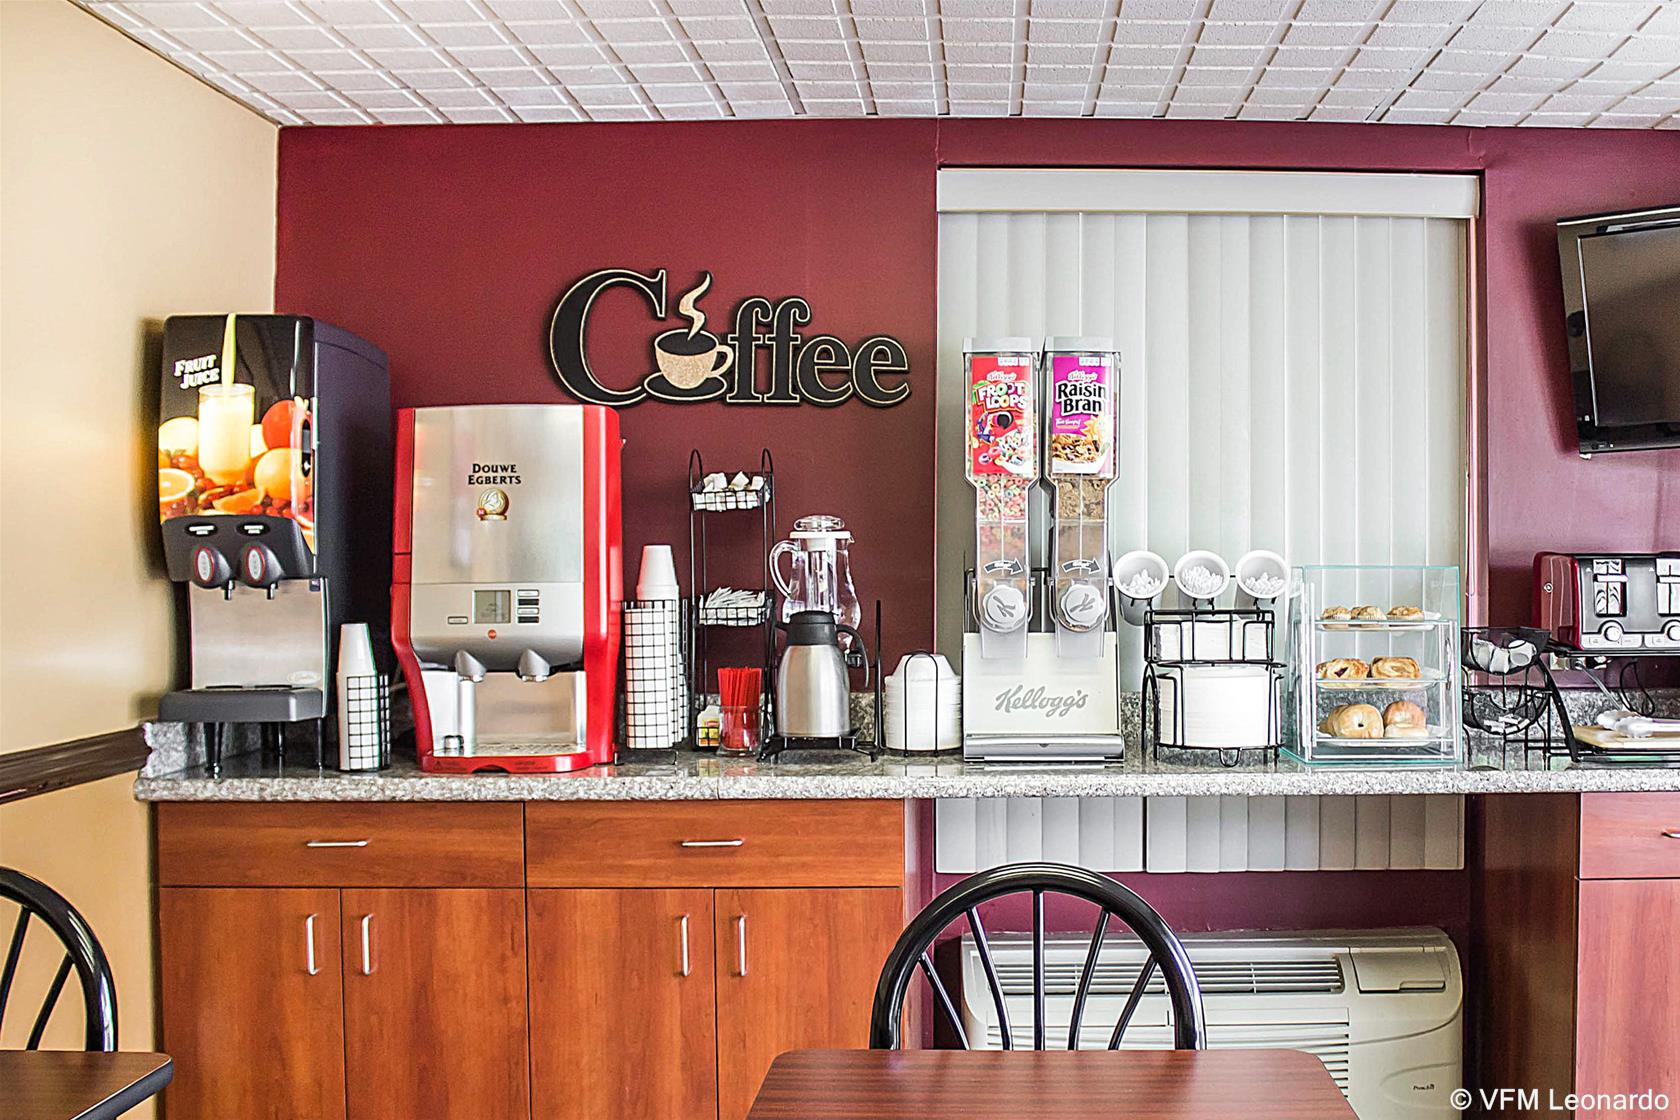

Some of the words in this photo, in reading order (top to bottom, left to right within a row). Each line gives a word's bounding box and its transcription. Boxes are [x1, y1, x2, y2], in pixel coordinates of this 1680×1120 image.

[978, 382, 1026, 401] FROOT
[1057, 382, 1107, 400] Raisin
[986, 394, 1027, 409] LOOPS
[1063, 398, 1101, 414] Bran
[472, 463, 517, 474] DOUWE
[467, 475, 522, 485] EGBERTS
[994, 684, 1089, 718] Kellogg's
